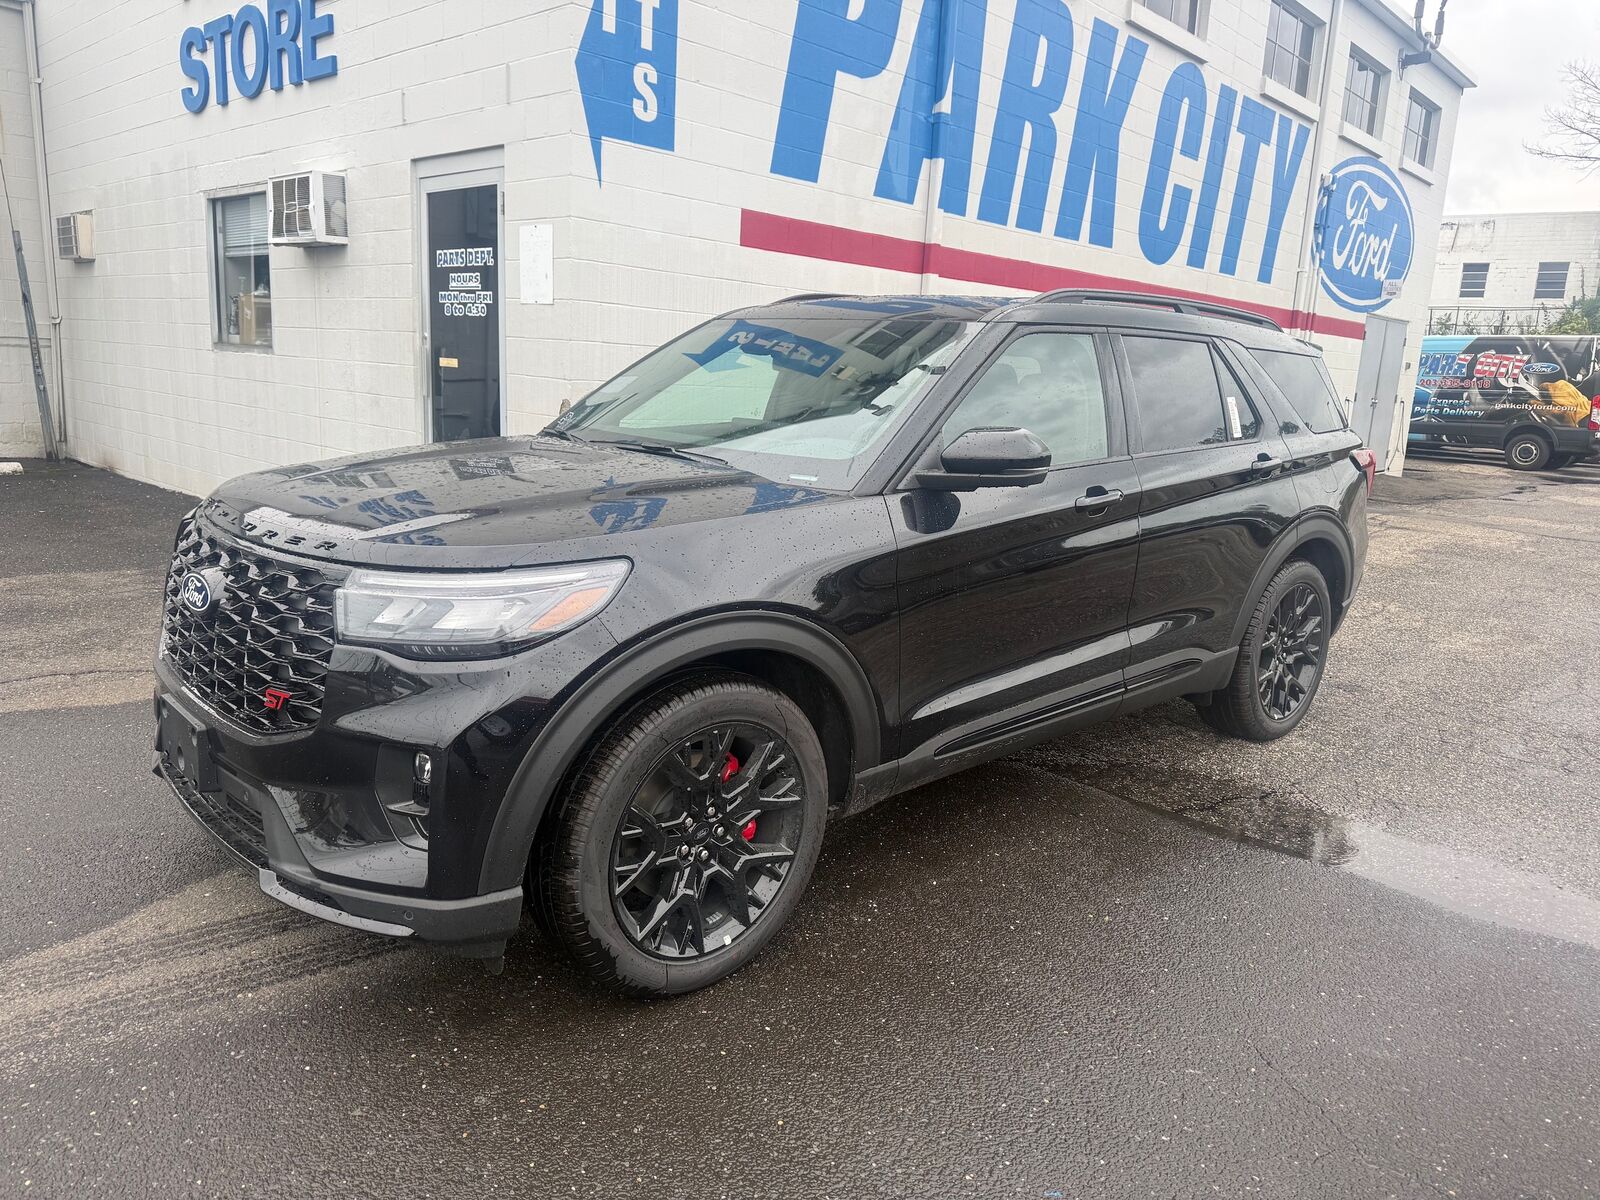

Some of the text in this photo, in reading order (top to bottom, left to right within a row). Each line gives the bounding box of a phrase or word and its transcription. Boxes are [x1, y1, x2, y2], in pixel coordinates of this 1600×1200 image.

[180, 0, 337, 113] STORE
[770, 0, 1311, 284] PARK CITY
[1333, 180, 1397, 282] Ford
[437, 247, 494, 267] PARTS DEPT.
[449, 273, 480, 286] HOURS
[439, 291, 493, 303] MON thru FRI
[444, 303, 487, 317] 8 to 4:30
[1418, 353, 1532, 379] PARK CITY
[1529, 364, 1553, 373] Ford
[1430, 398, 1470, 406] Express
[1494, 403, 1577, 412] parkcityford.com
[1414, 406, 1484, 417] Parts Delivery
[185, 577, 206, 607] Ford
[263, 689, 291, 710] ST
